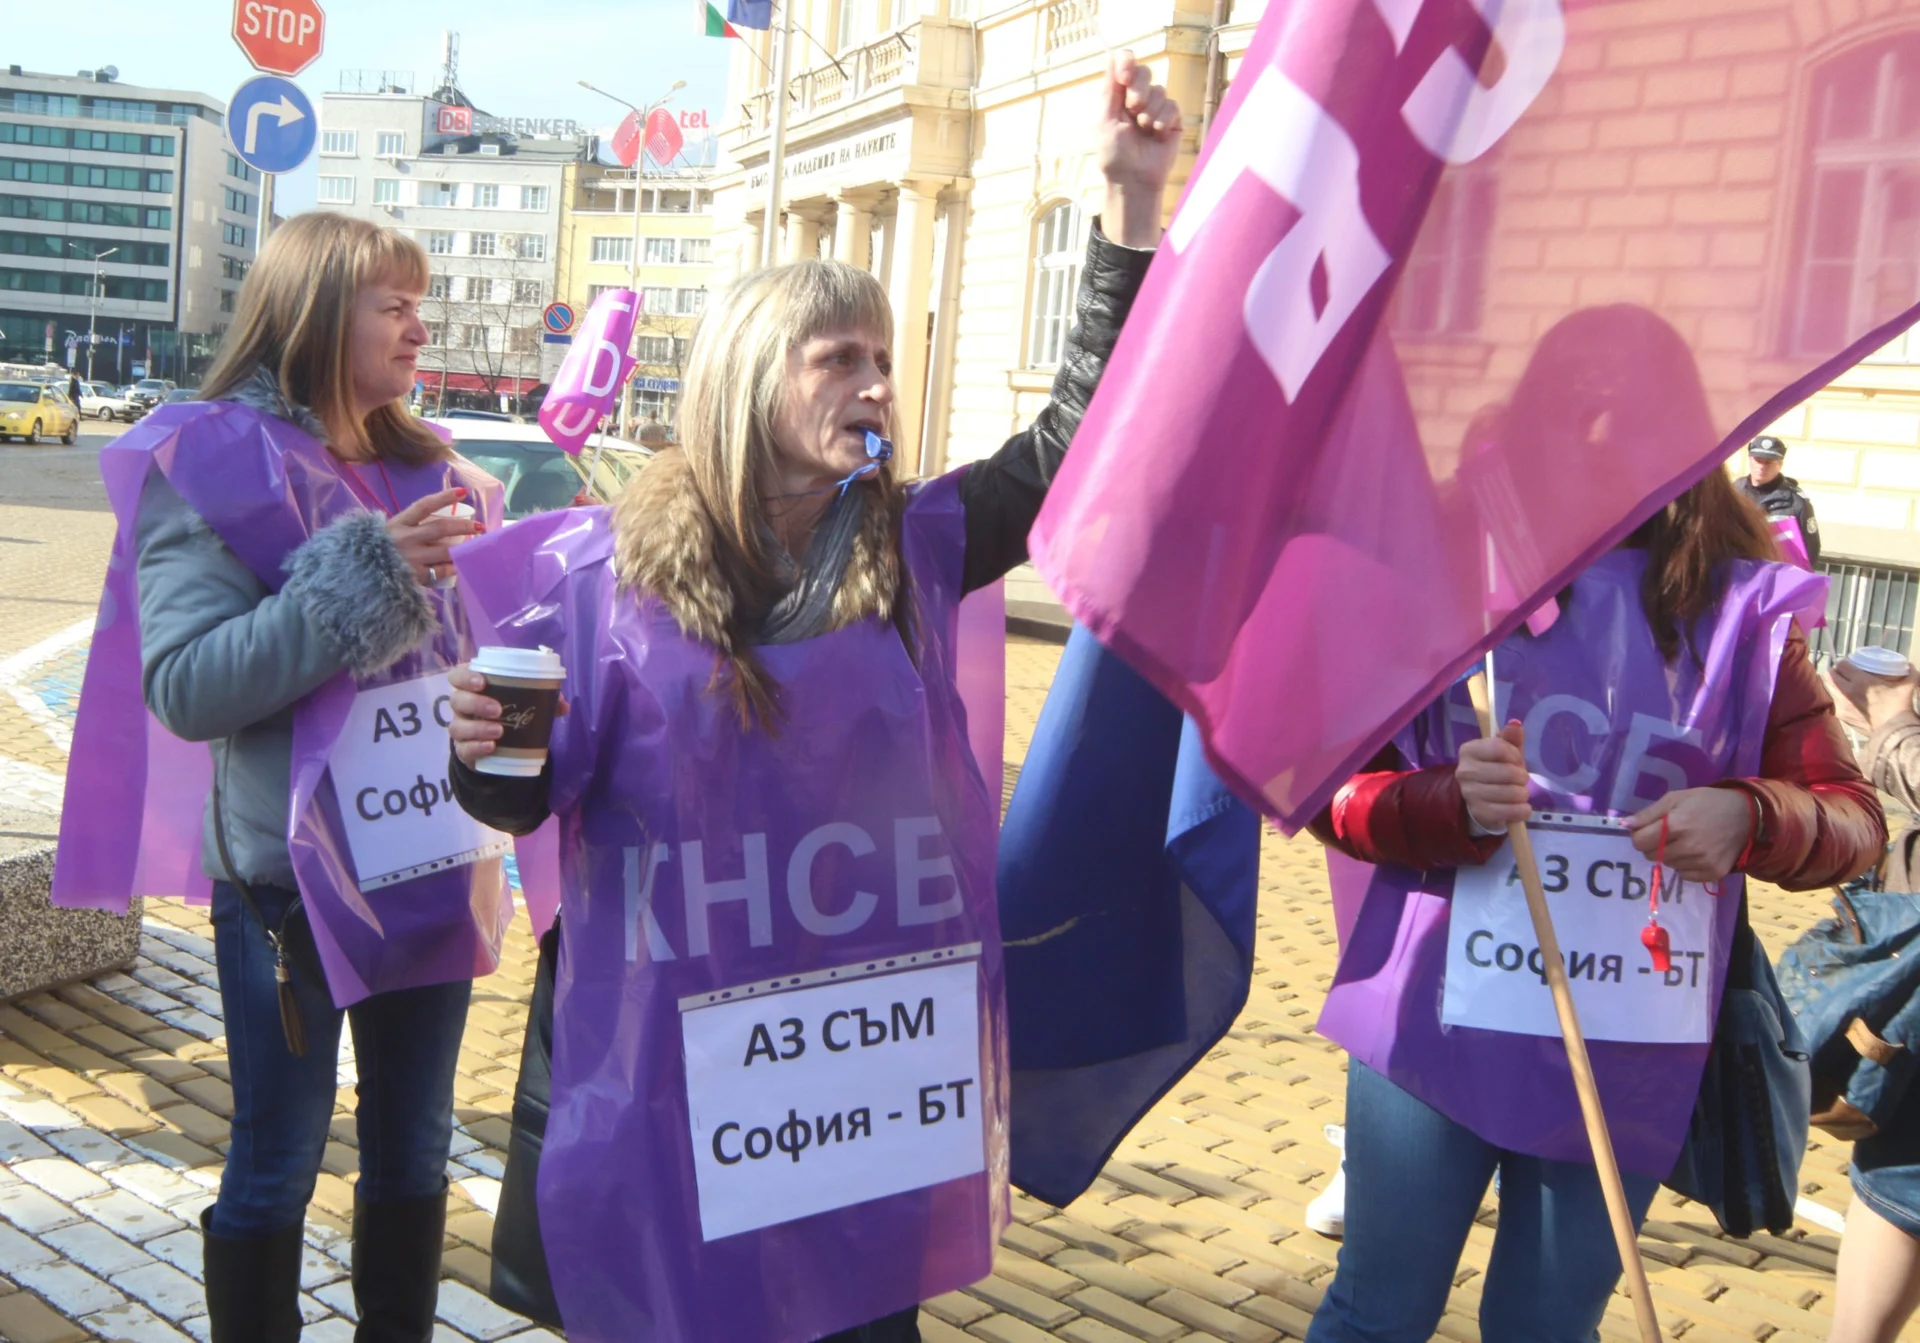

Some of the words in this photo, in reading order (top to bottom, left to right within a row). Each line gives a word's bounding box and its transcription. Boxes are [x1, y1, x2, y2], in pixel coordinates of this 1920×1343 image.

[243, 1, 316, 46] STOP
[441, 110, 467, 131] DB
[680, 109, 710, 129] tel
[793, 151, 836, 178] АКАДЕМИЯ
[839, 147, 851, 163] НА
[855, 132, 897, 160] НАУКИТЕ
[373, 701, 423, 743] АЗ
[355, 774, 454, 822] Софи
[1586, 859, 1683, 905] СЪМ
[743, 1017, 806, 1067] АЗ
[821, 997, 936, 1052] СЪМ
[712, 1107, 872, 1165] София
[918, 1078, 974, 1127] БТ
